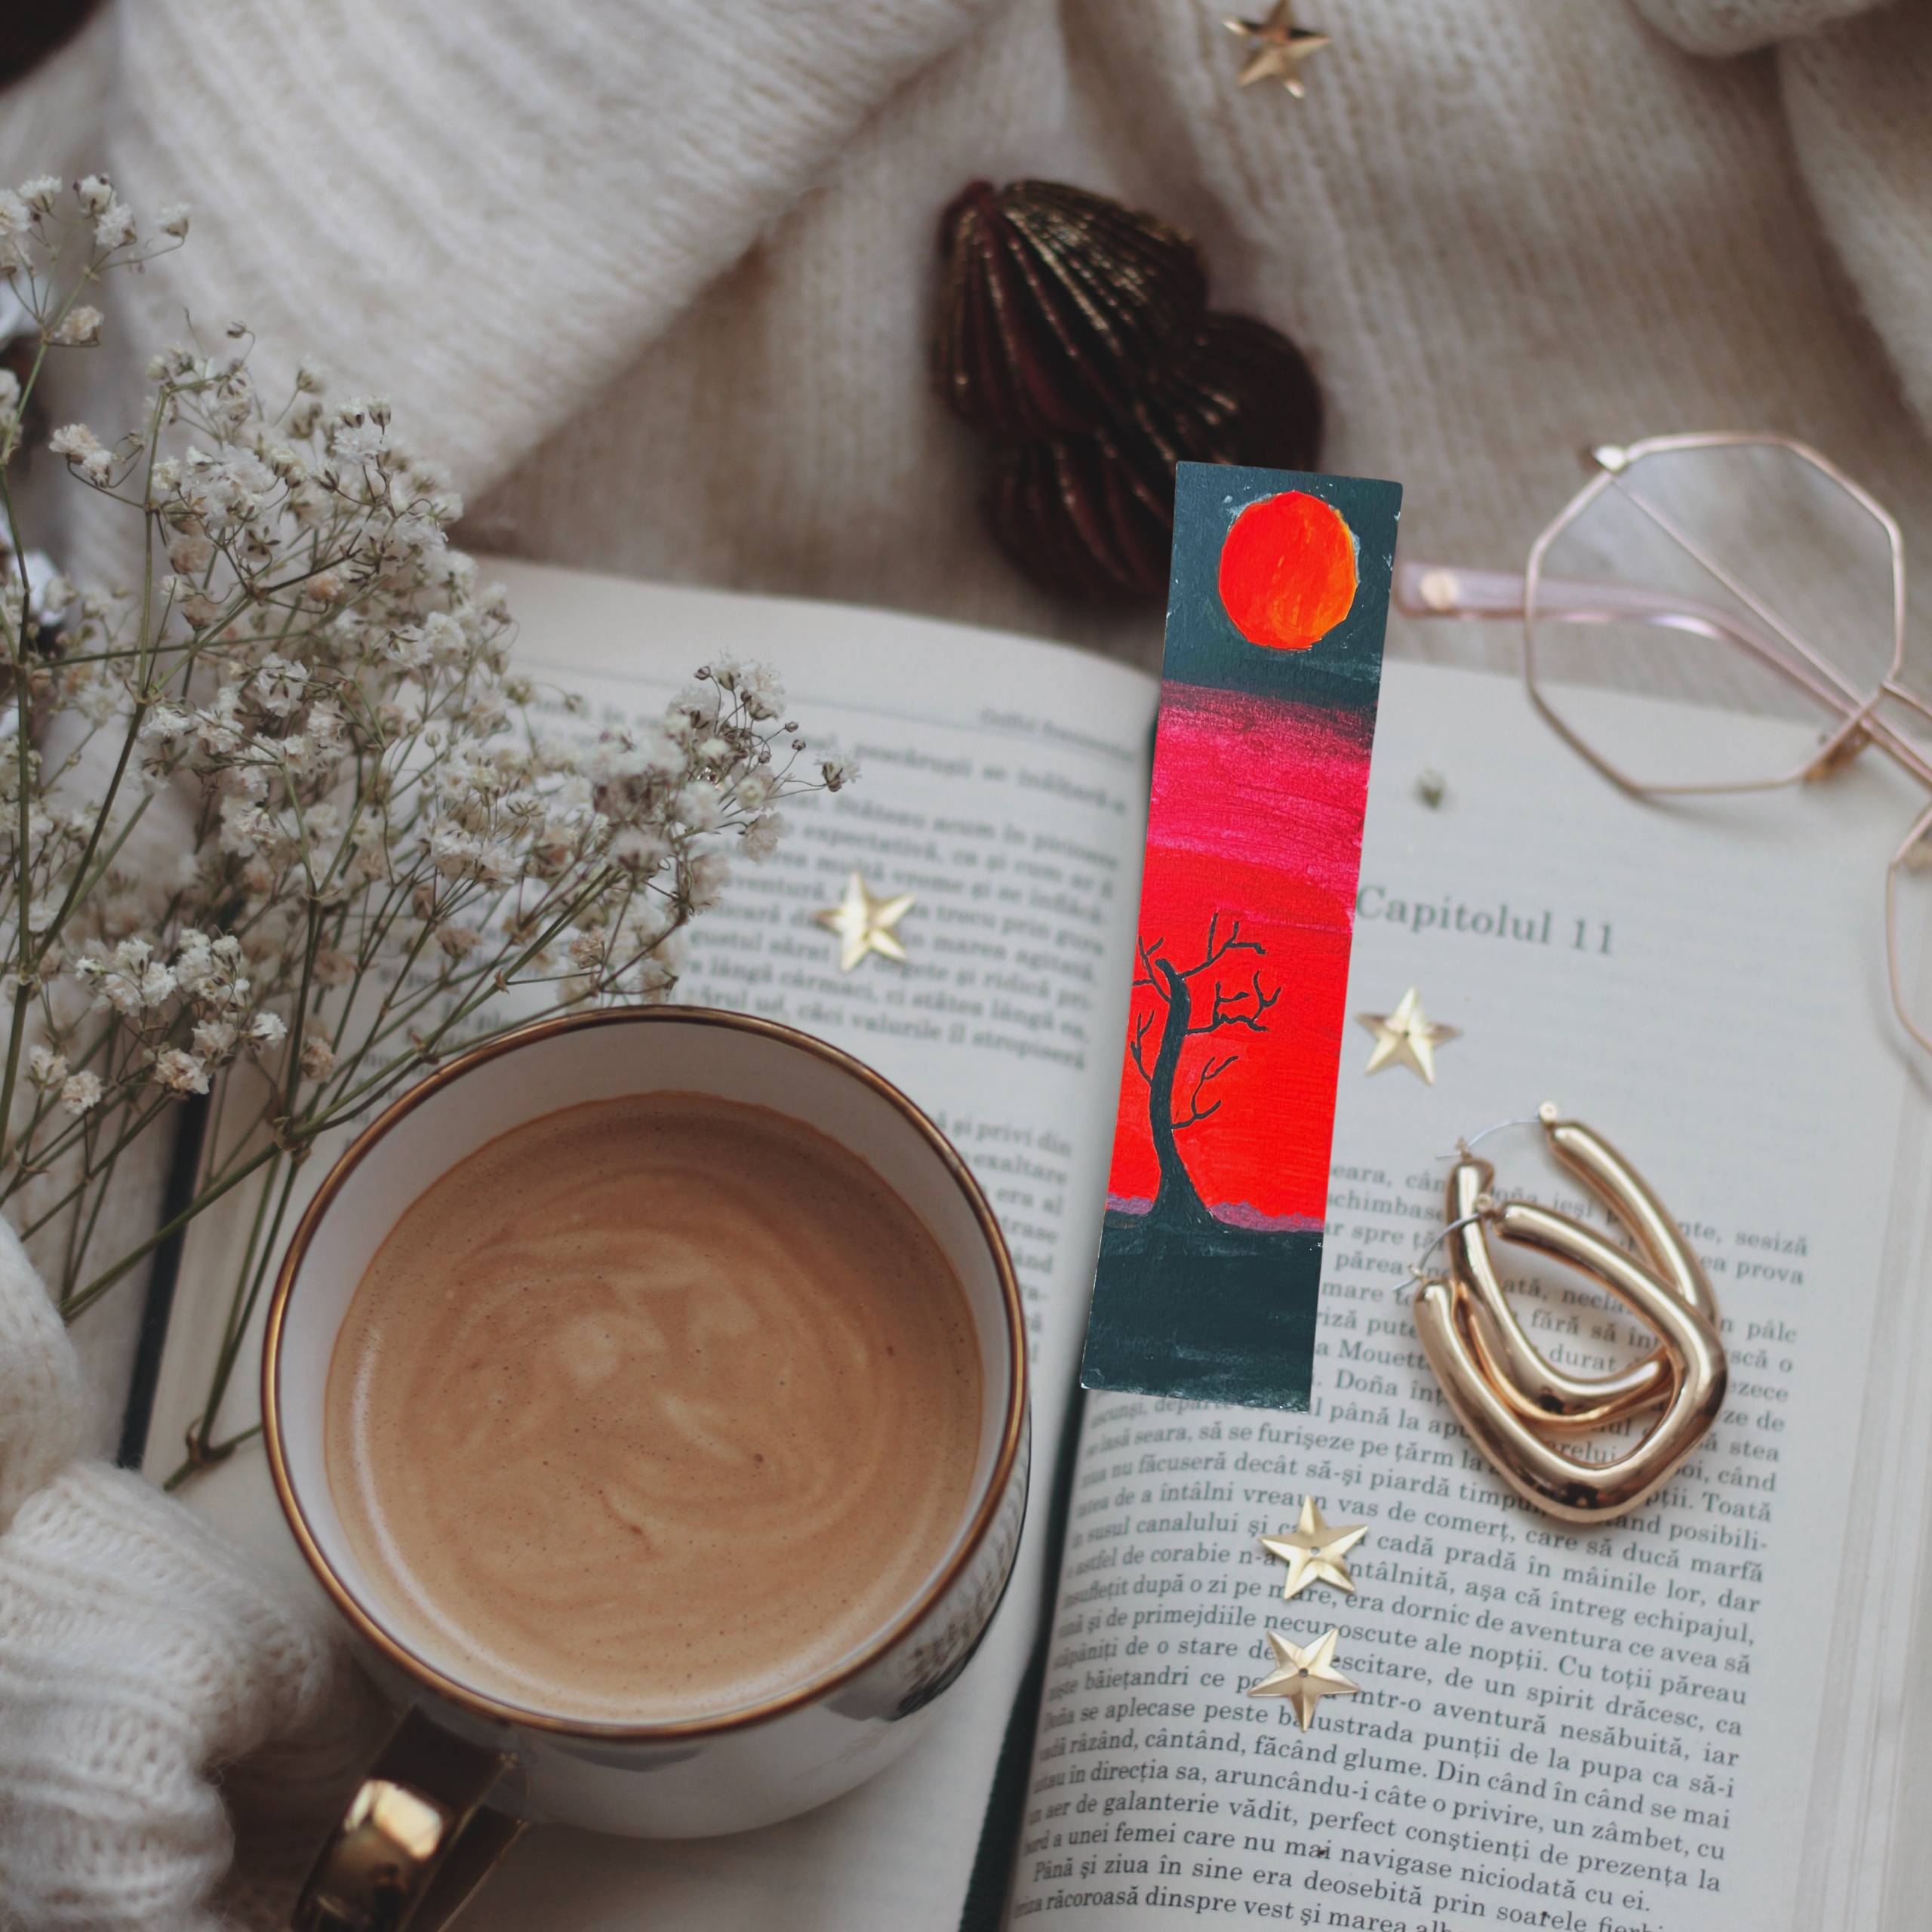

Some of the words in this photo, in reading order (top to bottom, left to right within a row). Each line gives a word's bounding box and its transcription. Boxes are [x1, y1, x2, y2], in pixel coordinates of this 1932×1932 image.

[1355, 884, 1552, 945] Capitolul
[1572, 917, 1613, 955] 11
[1351, 1226, 1404, 1245] spre
[1735, 1231, 1808, 1257] sesiză
[1735, 1261, 1804, 1286] prova
[1335, 1251, 1403, 1276] părea
[1746, 1317, 1798, 1343] pâlc
[1531, 1308, 1579, 1336] fără
[1591, 1322, 1617, 1343] să
[1779, 1358, 1794, 1373] o
[1549, 1343, 1617, 1373] durat
[1329, 1401, 1389, 1427] până
[1398, 1408, 1420, 1431] la
[1718, 1466, 1777, 1493] când
[1335, 1368, 1398, 1397] Doña
[1729, 1441, 1780, 1463] stea
[1755, 1411, 1785, 1432] de
[1133, 1426, 1193, 1444] seara,
[1198, 1421, 1223, 1441] să
[1228, 1426, 1253, 1441] se
[1359, 1440, 1389, 1459] pe
[1461, 1450, 1481, 1472] la
[1702, 1491, 1771, 1523] Toată
[1138, 1454, 1226, 1474] făcuseră
[1233, 1451, 1297, 1475] decât
[1361, 1467, 1450, 1498] piardă
[1668, 1524, 1767, 1551] posibili-
[1136, 1511, 1238, 1534] canalului
[1377, 1534, 1433, 1558] cadă
[1444, 1546, 1516, 1572] pradă
[1527, 1555, 1551, 1578] în
[1562, 1566, 1657, 1595] mâinile
[1666, 1578, 1706, 1607] lor,
[1718, 1588, 1761, 1613] dar
[1159, 1481, 1234, 1503] întâlni
[1338, 1499, 1379, 1517] vas
[1387, 1500, 1417, 1523] de
[1423, 1512, 1515, 1543] comerț,
[1525, 1531, 1578, 1549] care
[1586, 1538, 1612, 1558] să
[1622, 1542, 1679, 1569] ducă
[1690, 1558, 1763, 1583] marfă
[1122, 1544, 1145, 1565] de
[1151, 1542, 1232, 1564] corabie
[1238, 1549, 1277, 1567] n-a
[1515, 1587, 1541, 1607] că
[1550, 1596, 1626, 1626] întreg
[1633, 1608, 1755, 1647] echipajul,
[1133, 1574, 1184, 1598] după
[1189, 1579, 1203, 1593] o
[1207, 1580, 1227, 1594] zi
[1232, 1581, 1262, 1600] pe
[1345, 1592, 1384, 1612] era
[1391, 1595, 1470, 1626] dornic
[1475, 1609, 1504, 1632] de
[1509, 1621, 1622, 1654] aventura
[1628, 1642, 1655, 1657] ce
[1660, 1647, 1717, 1669] avea
[1724, 1654, 1750, 1675] să
[1124, 1635, 1149, 1657] de
[1156, 1640, 1170, 1655] o
[1177, 1638, 1238, 1657] stare
[1444, 1666, 1474, 1690] de
[1484, 1678, 1515, 1698] un
[1526, 1687, 1594, 1711] spirit
[1605, 1695, 1704, 1732] drăcesc,
[1715, 1719, 1742, 1737] ca
[1131, 1604, 1257, 1630] primejdiile
[1424, 1633, 1462, 1656] ale
[1469, 1644, 1548, 1672] nopții.
[1558, 1655, 1592, 1679] Cu
[1601, 1665, 1651, 1690] toții
[1659, 1675, 1746, 1706] păreau
[1080, 1706, 1100, 1722] se
[1104, 1697, 1195, 1723] aplecase
[1202, 1704, 1269, 1724] peste
[1423, 1732, 1499, 1759] punții
[1509, 1742, 1539, 1765] de
[1548, 1747, 1570, 1771] la
[1580, 1759, 1642, 1783] pupa
[1652, 1771, 1678, 1789] ca
[1688, 1774, 1734, 1798] să-i
[1199, 1672, 1226, 1687] ce
[1432, 1703, 1546, 1735] aventură
[1559, 1724, 1690, 1761] nesăbuită,
[1703, 1742, 1741, 1767] iar
[1069, 1727, 1140, 1754] râzând,
[1144, 1731, 1246, 1755] cântând,
[1254, 1734, 1338, 1764] făcând
[1343, 1747, 1427, 1778] glume.
[1435, 1759, 1481, 1787] Din
[1487, 1776, 1547, 1799] când
[1553, 1780, 1577, 1804] în
[1584, 1792, 1644, 1814] când
[1650, 1804, 1677, 1819] se
[1683, 1808, 1730, 1830] mai
[1091, 1758, 1169, 1783] direcția
[1175, 1766, 1207, 1783] sa,
[1214, 1769, 1367, 1801] aruncându-i
[1374, 1784, 1427, 1809] câte
[1432, 1798, 1447, 1813] o
[1451, 1801, 1544, 1833] privire,
[1553, 1819, 1584, 1837] un
[1591, 1821, 1689, 1857] zâmbet,
[1697, 1843, 1724, 1861] cu
[1033, 1857, 1073, 1882] Până
[1104, 1853, 1149, 1875] ziua
[1158, 1854, 1182, 1876] în
[1192, 1857, 1244, 1881] sine
[1252, 1869, 1292, 1888] era
[1303, 1868, 1423, 1906] deosebită
[1432, 1894, 1485, 1917] prin
[1068, 1823, 1109, 1844] unei
[1114, 1821, 1175, 1844] femei
[1183, 1830, 1236, 1849] care
[1243, 1835, 1275, 1854] nu
[1284, 1841, 1331, 1860] mai
[1340, 1847, 1452, 1878] navigase
[1460, 1867, 1576, 1900] niciodată
[1584, 1888, 1613, 1906] cu
[1622, 1894, 1650, 1912] ei.
[1076, 1793, 1098, 1813] de
[1103, 1789, 1220, 1817] galanterie
[1229, 1798, 1298, 1826] vădit,
[1308, 1810, 1396, 1837] perfect
[1539, 1843, 1569, 1866] de
[1577, 1854, 1687, 1887] prezența
[1698, 1868, 1721, 1893] la
[1046, 1887, 1140, 1912] răcoroasă
[1145, 1884, 1237, 1915] dinspre
[1243, 1900, 1294, 1920] vest
[1327, 1911, 1407, 1932] marea
